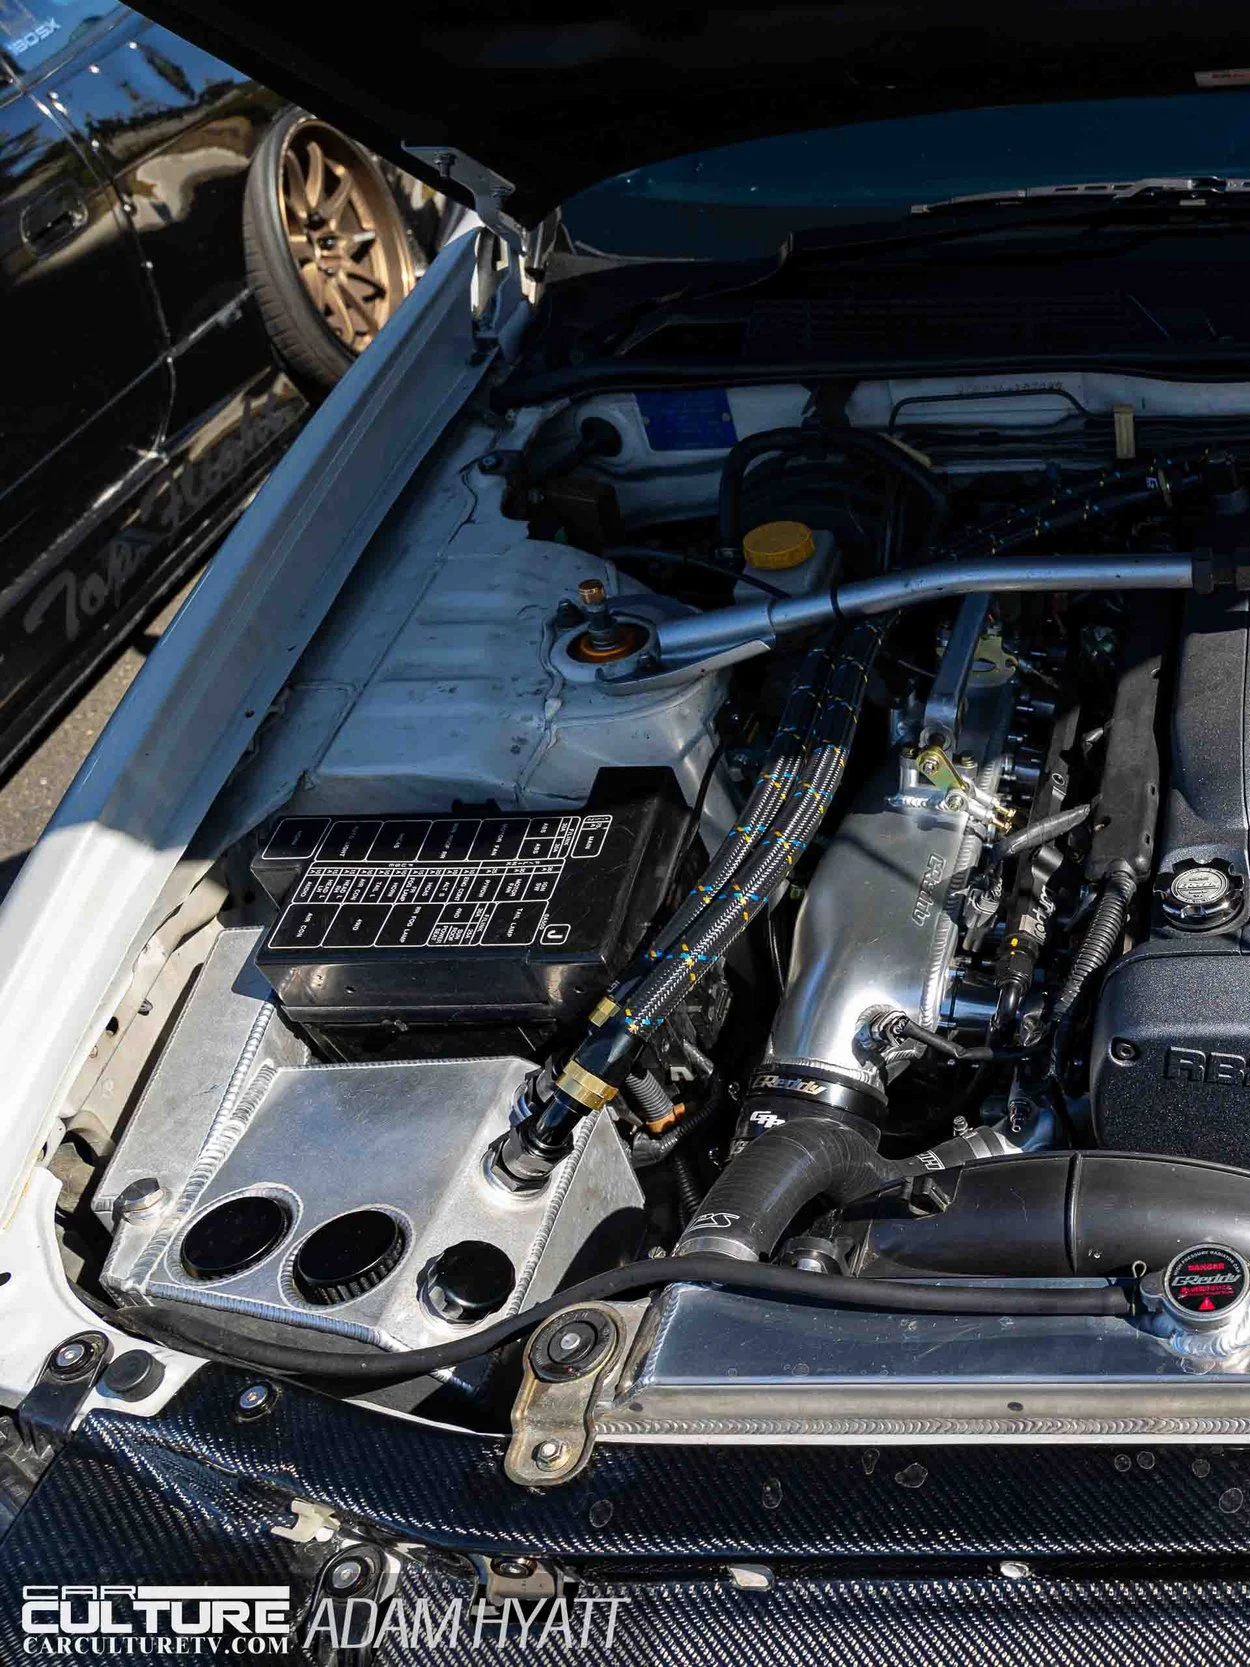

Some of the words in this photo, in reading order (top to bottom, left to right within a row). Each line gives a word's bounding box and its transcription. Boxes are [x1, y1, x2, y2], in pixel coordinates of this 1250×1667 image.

[540, 823, 549, 833] ABS
[562, 828, 574, 846] F/LINK
[585, 836, 594, 849] MAIN
[491, 845, 500, 856] FAN
[532, 843, 541, 854] ABS
[322, 879, 334, 894] HEAD
[339, 879, 351, 894] HEAD
[357, 878, 366, 887] AIR
[372, 881, 382, 892] TAIL
[406, 877, 415, 888] FOG
[442, 881, 450, 891] ALT
[460, 877, 470, 887] ENG
[505, 883, 514, 893] FAN
[510, 879, 522, 897] MOTOR
[300, 881, 312, 897] AUDIO
[350, 889, 361, 900] CON
[387, 882, 398, 897] HORN
[454, 888, 464, 901] CONT
[400, 889, 409, 902] LAMP
[304, 912, 313, 922] AIR
[453, 907, 462, 919] 4WD
[513, 908, 523, 920] TAIL
[352, 919, 362, 931] 4WD
[407, 916, 417, 927] FOG
[477, 914, 490, 932] F/LINK
[296, 925, 307, 937] CON
[400, 928, 410, 943] LAMP
[431, 928, 441, 941] SEAT
[436, 925, 449, 944] POWER
[448, 927, 458, 941] ROOF
[454, 929, 463, 940] SUN
[507, 922, 517, 937] LAMP
[547, 930, 563, 939] J
[751, 1075, 828, 1095] GReddy
[1181, 1250, 1209, 1264] PRESSURE
[1210, 1250, 1235, 1265] RADIATOR
[1187, 1262, 1225, 1271] DANGER
[1171, 1272, 1242, 1287] GReddy
